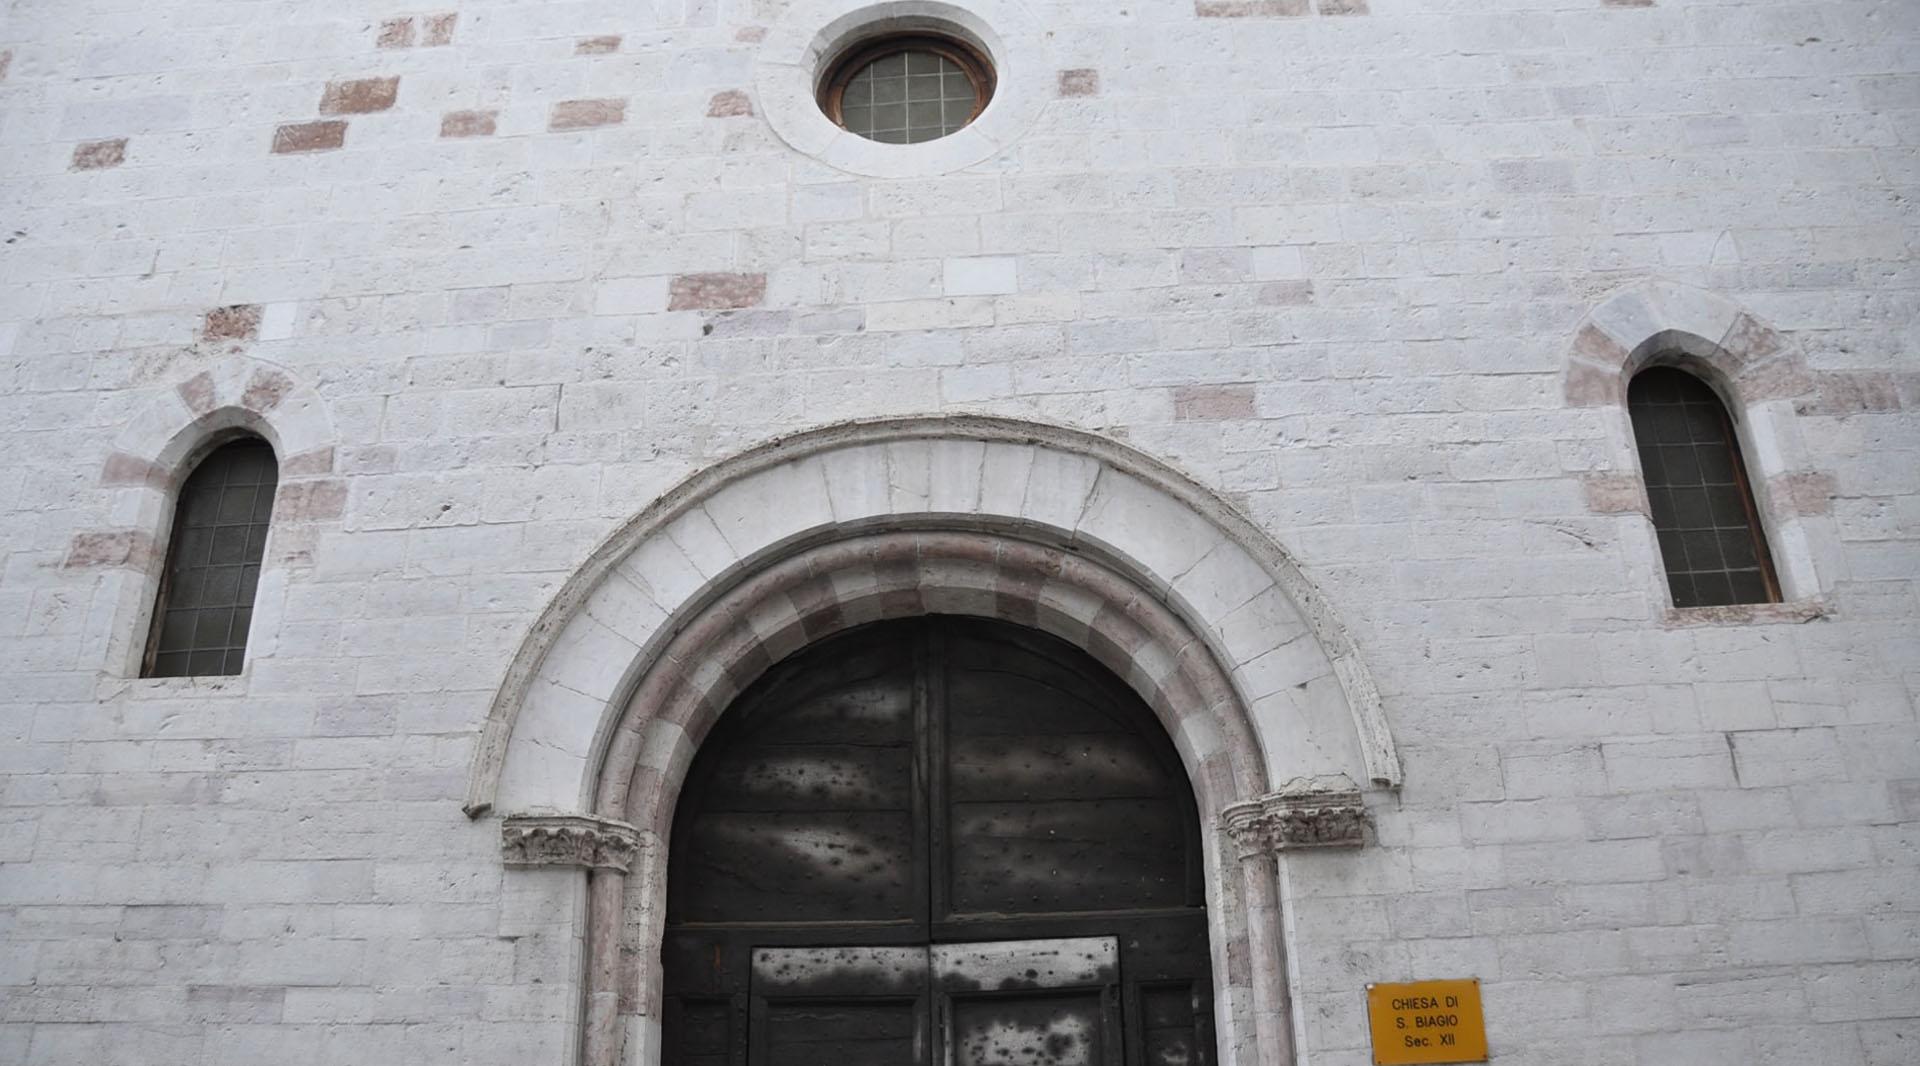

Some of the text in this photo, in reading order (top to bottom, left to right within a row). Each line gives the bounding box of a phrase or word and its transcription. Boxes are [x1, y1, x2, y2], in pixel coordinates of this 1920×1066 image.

[1392, 996, 1458, 1010] CHIESA DI
[1396, 1015, 1458, 1029] S. BIAGIO
[1404, 1034, 1455, 1048] Sec. XII
